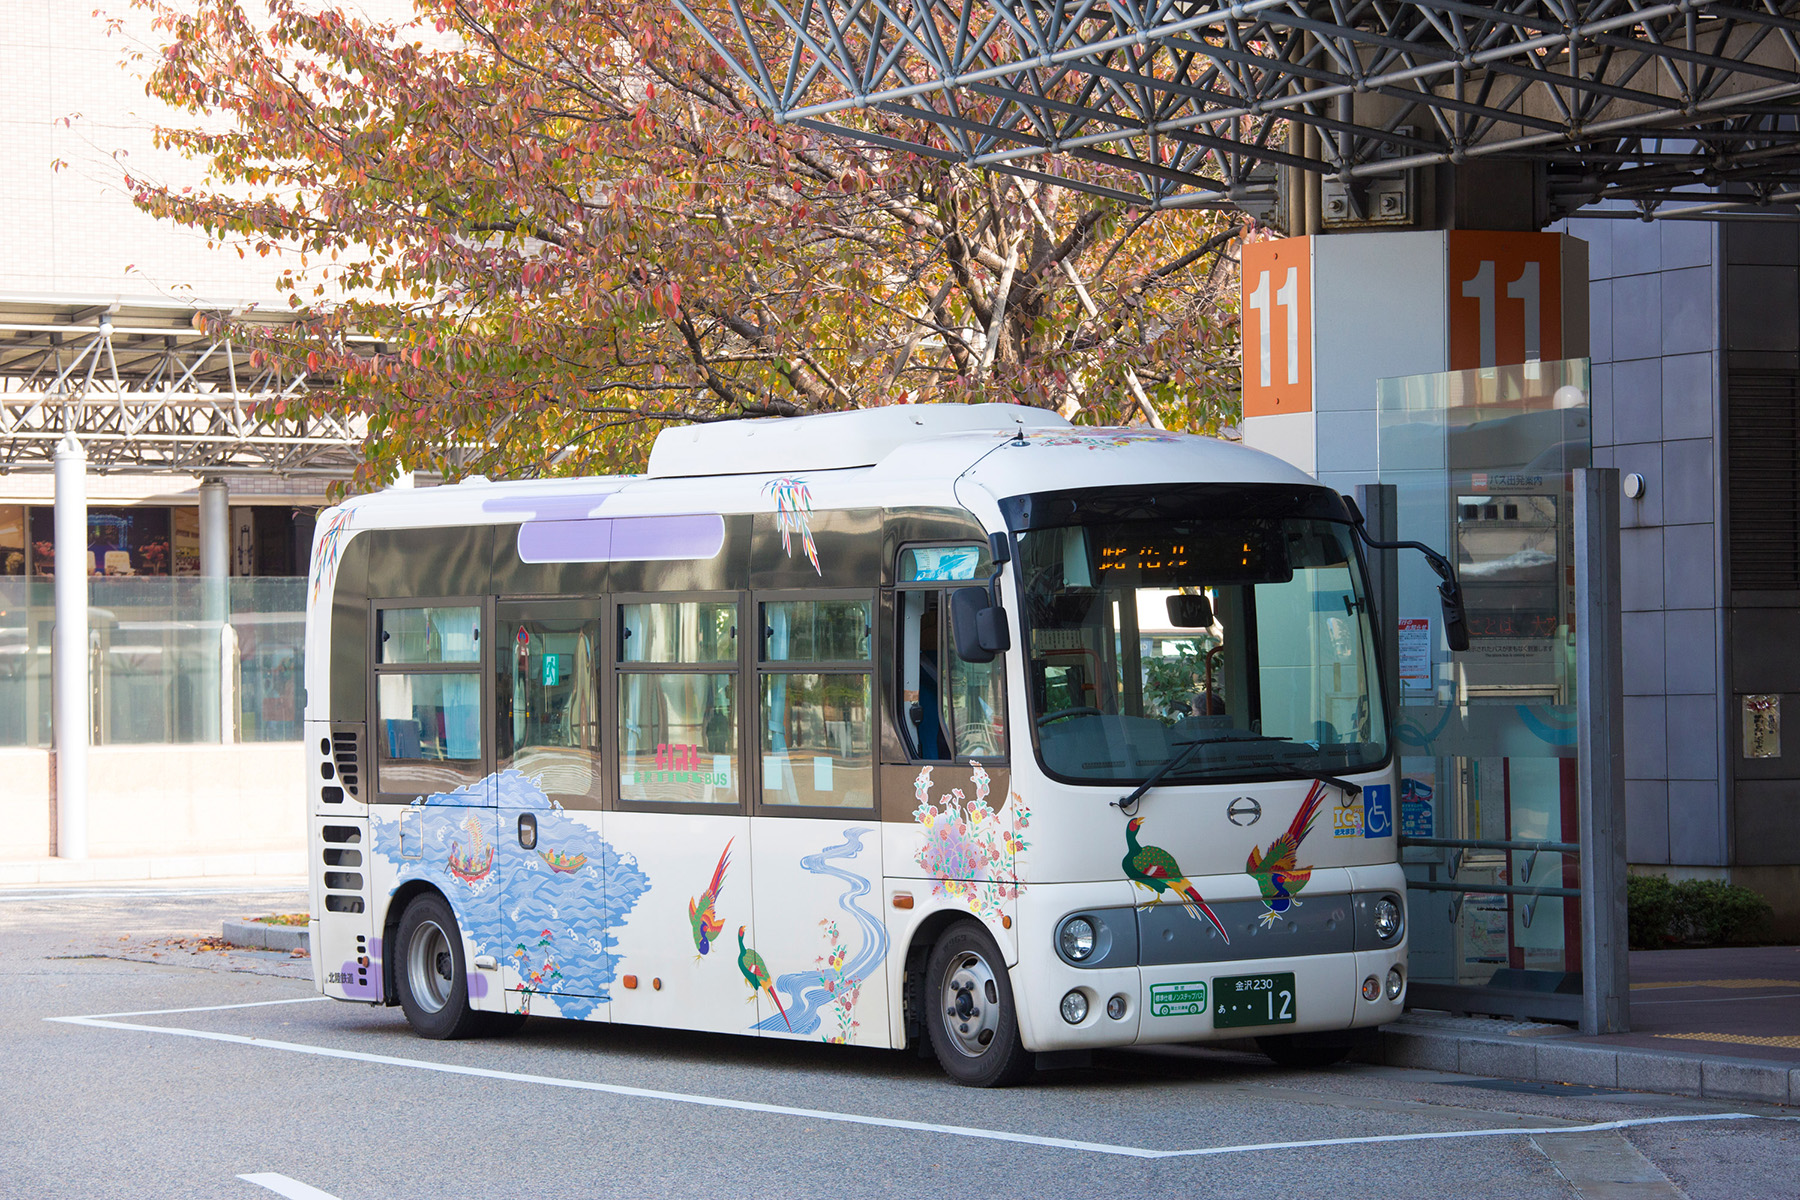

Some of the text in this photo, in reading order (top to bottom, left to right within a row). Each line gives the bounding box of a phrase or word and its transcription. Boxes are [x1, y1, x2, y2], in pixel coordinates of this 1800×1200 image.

[1461, 260, 1542, 380] 11
[1249, 266, 1298, 387] 11
[1489, 475, 1543, 487] バス出発案内
[704, 773, 728, 786] BUS
[1235, 979, 1273, 991] 金沢230
[1217, 1004, 1226, 1014] あ
